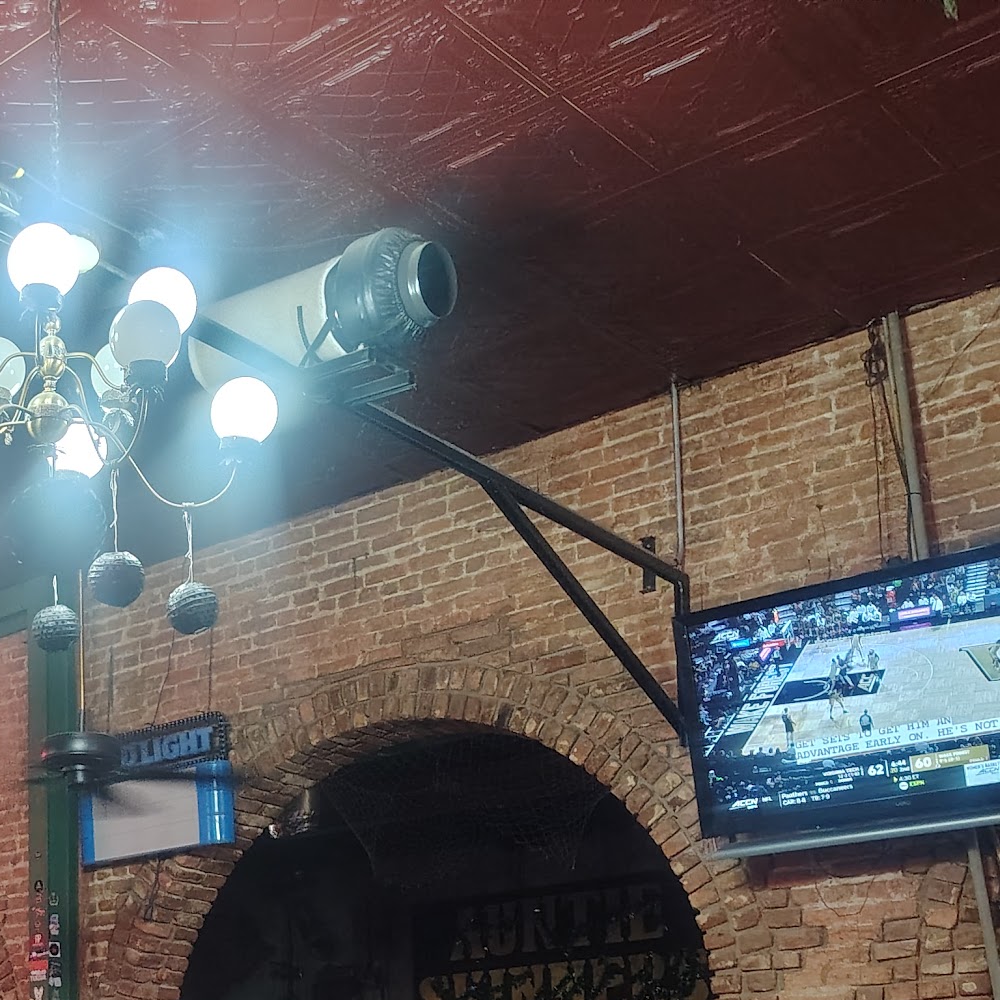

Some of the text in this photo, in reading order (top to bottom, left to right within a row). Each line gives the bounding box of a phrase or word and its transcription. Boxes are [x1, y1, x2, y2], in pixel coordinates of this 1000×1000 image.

[797, 719, 999, 760] ADVANTAGE EARLY ON. HE'S NOT
[914, 756, 933, 769] 60
[867, 763, 885, 777] 62
